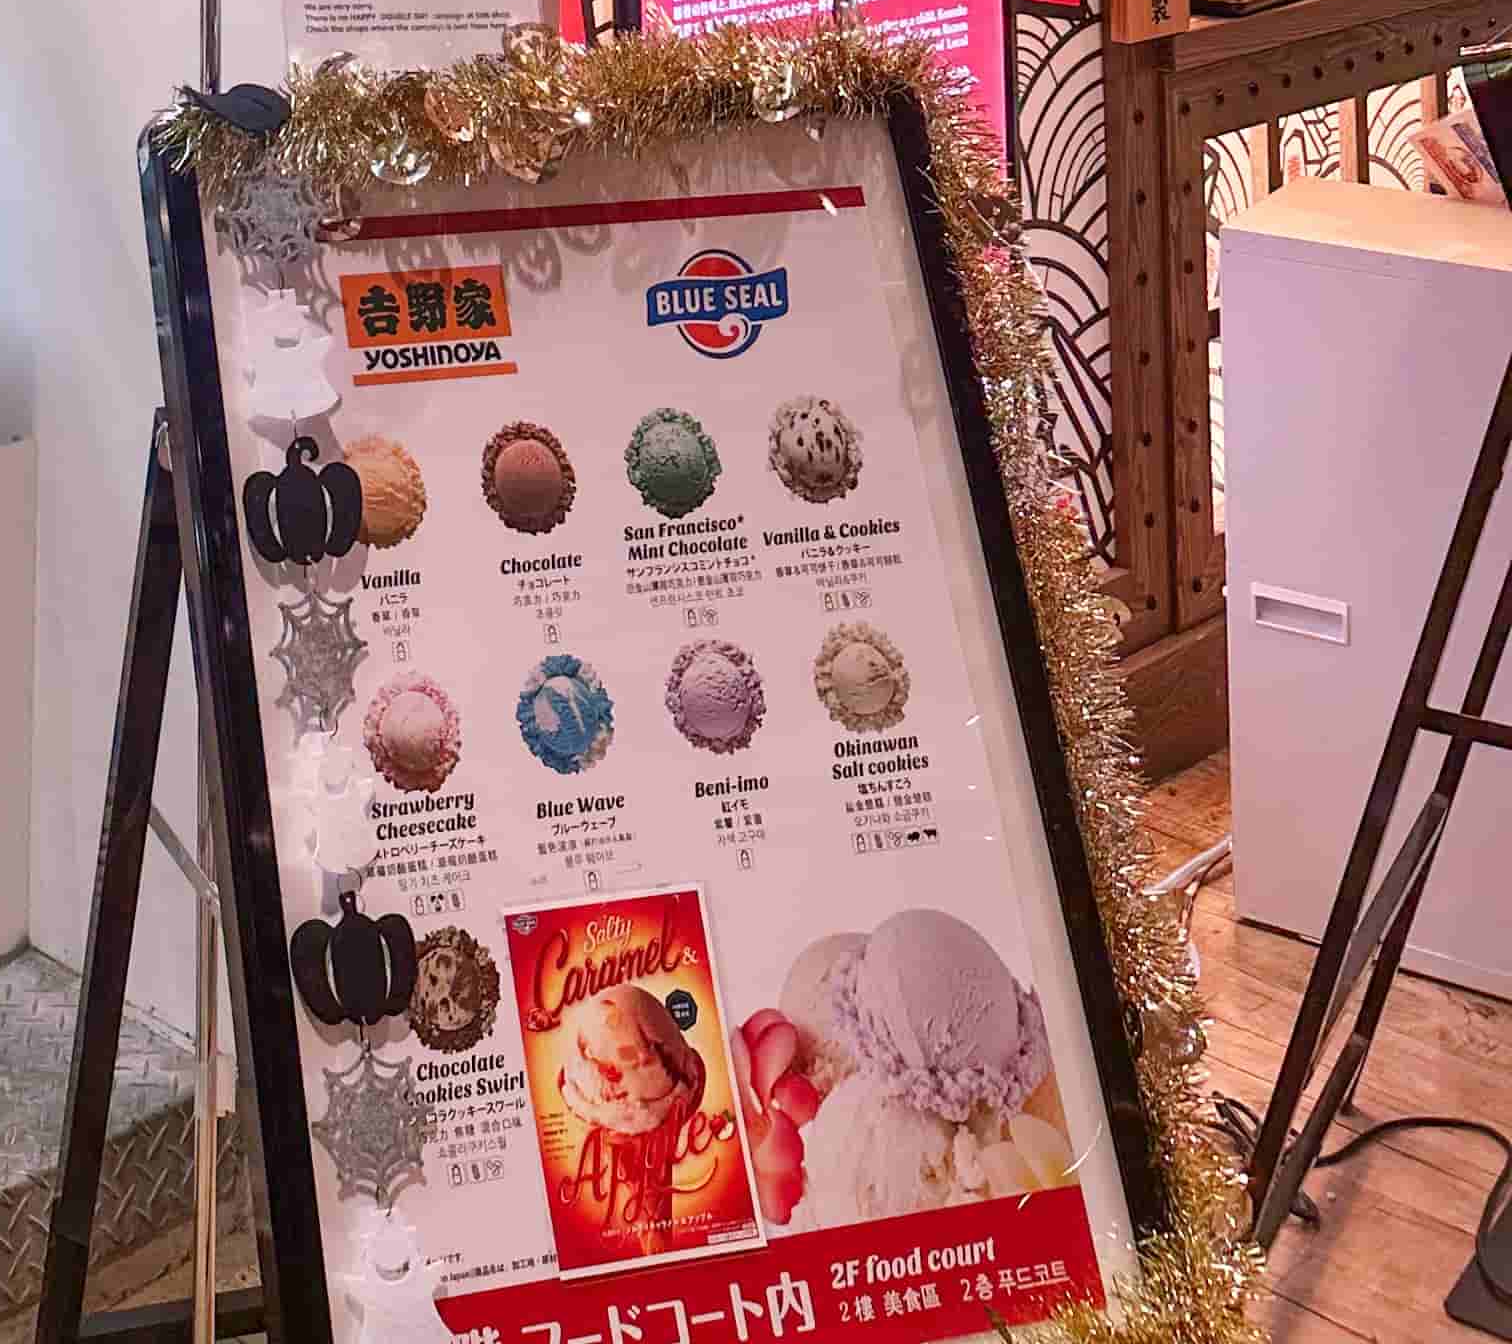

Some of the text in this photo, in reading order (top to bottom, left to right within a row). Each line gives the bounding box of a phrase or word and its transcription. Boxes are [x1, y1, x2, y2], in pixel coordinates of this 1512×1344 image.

[357, 278, 498, 337] 吉野家
[655, 278, 785, 315] BLUE SEAL
[624, 523, 656, 542] San
[762, 519, 901, 547] Vanilla & Cookies
[628, 535, 749, 561] Mint Chocolate
[500, 552, 584, 575] Chocolate
[360, 568, 422, 591] Vanilla
[378, 592, 409, 607] バニラ
[833, 735, 920, 759] Okinawan
[832, 753, 930, 781] Salt cookies
[695, 775, 770, 798] Beni-imo
[371, 792, 475, 820] Strawberry
[536, 794, 626, 820] Blue Wave
[376, 812, 478, 841] Cheesecake
[583, 912, 633, 953] Salty
[534, 904, 698, 1015] Caramel &
[416, 1053, 506, 1082] Chocolate
[476, 1071, 525, 1097] Swirl
[558, 1098, 715, 1233] Apple
[830, 1236, 996, 1289] 2F food court
